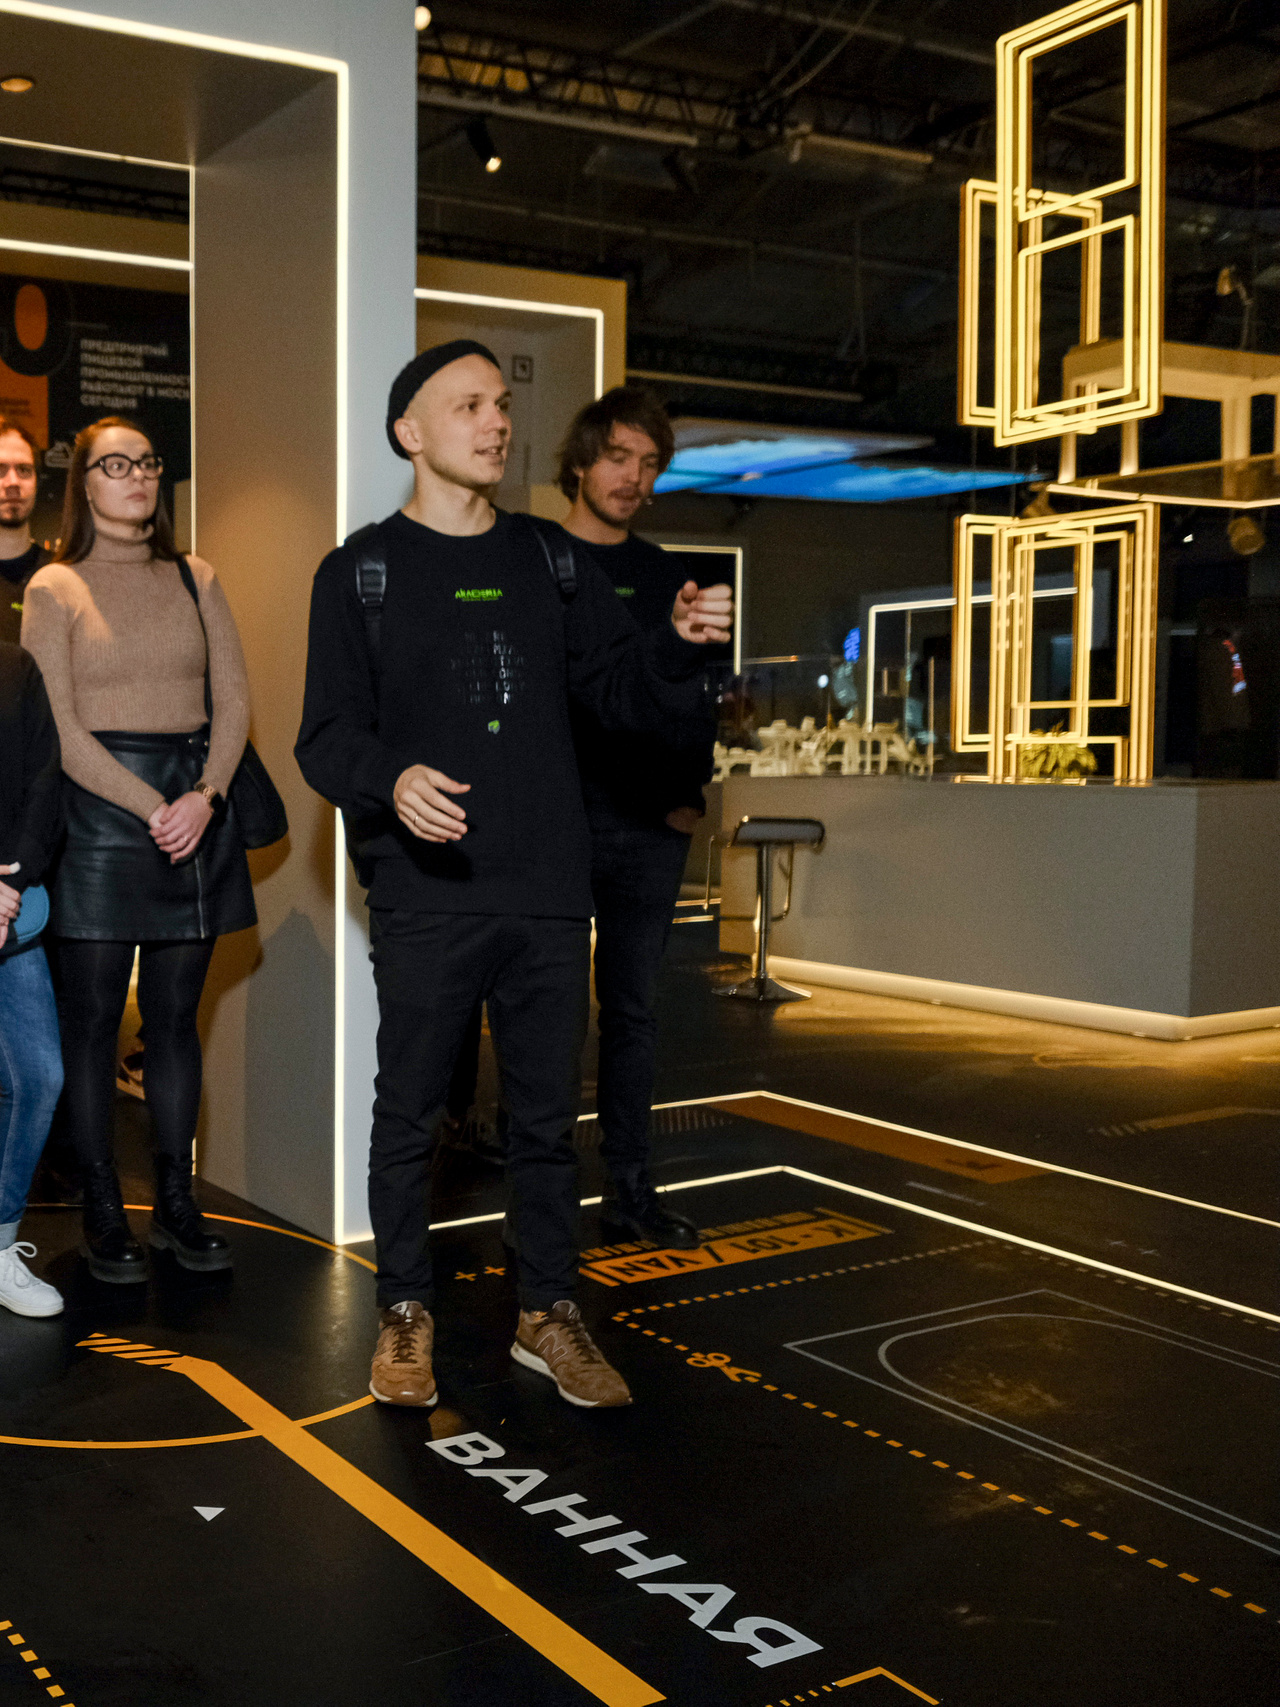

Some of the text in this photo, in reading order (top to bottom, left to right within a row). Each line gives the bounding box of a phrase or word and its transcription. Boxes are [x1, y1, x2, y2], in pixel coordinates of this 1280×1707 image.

[726, 1234, 798, 1254] 101
[607, 1254, 700, 1278] VAN
[424, 1431, 824, 1669] ВАННАЯ
